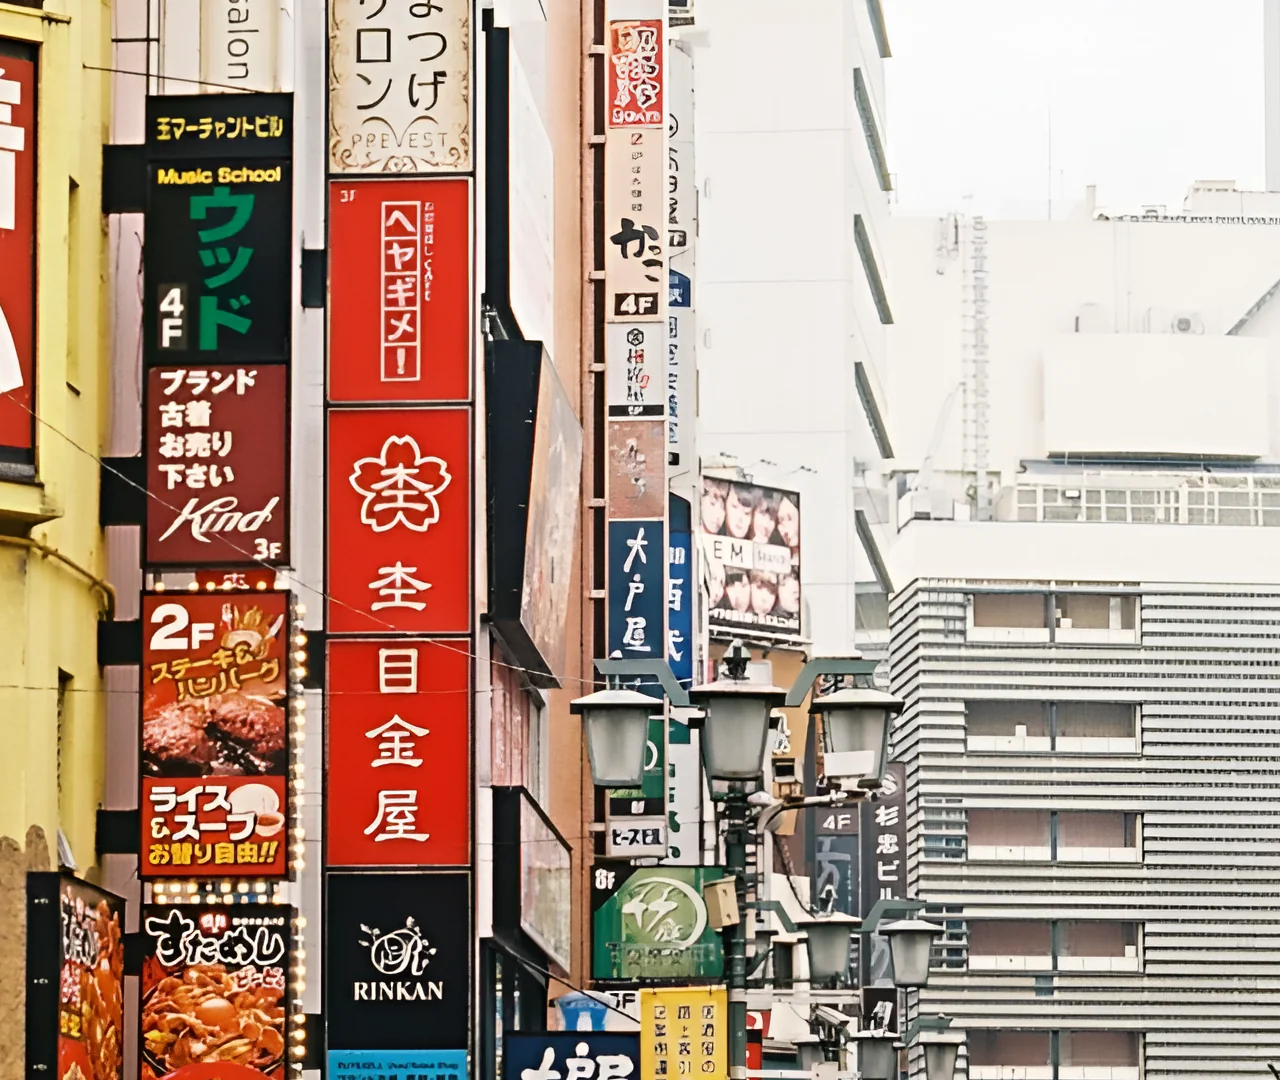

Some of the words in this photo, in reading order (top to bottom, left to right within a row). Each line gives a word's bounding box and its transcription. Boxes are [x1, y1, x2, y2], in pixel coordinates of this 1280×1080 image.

[227, 0, 259, 80] alon
[157, 168, 213, 185] Music
[217, 166, 282, 184] School
[189, 186, 256, 350] ウッド
[158, 287, 185, 349] 4F
[618, 294, 657, 315] 4F
[159, 368, 258, 396] ブランド
[158, 400, 213, 428] 古着
[158, 431, 233, 459] お売り
[157, 463, 235, 490] 下さい
[158, 496, 280, 543] Kind
[253, 538, 282, 561] 3F
[623, 527, 652, 652] 大戸屋
[150, 603, 215, 650] 2F
[149, 785, 232, 813] ライス
[822, 813, 852, 830] 4F
[148, 841, 278, 866] お替り自由!!
[353, 981, 444, 1001] RINKAN
